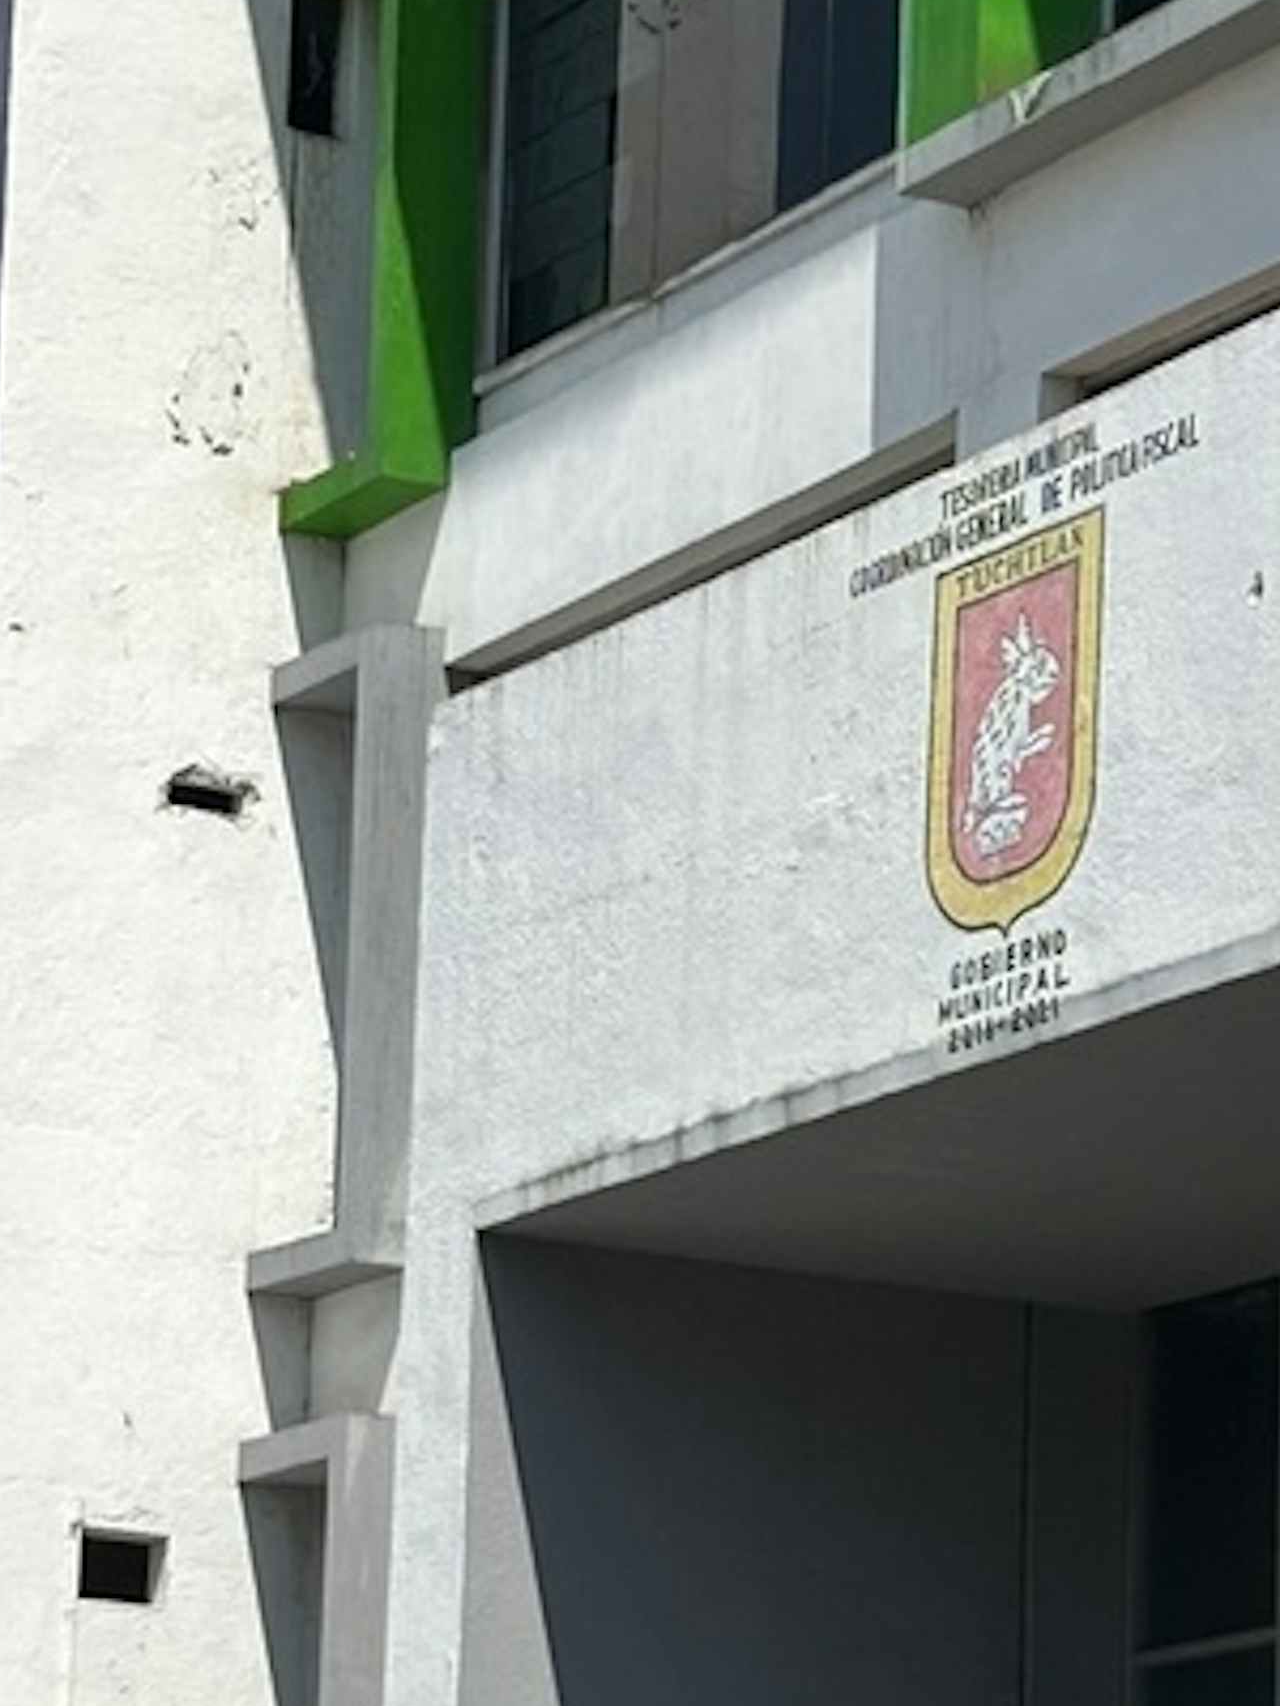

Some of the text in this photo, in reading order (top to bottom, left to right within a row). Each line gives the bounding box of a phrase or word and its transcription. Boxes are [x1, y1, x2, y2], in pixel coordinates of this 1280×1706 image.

[957, 491, 1029, 552] GENERAL
[1042, 476, 1063, 512] DE
[951, 928, 1067, 990] GOBIERNO
[938, 963, 1070, 1027] MUNICIPAL
